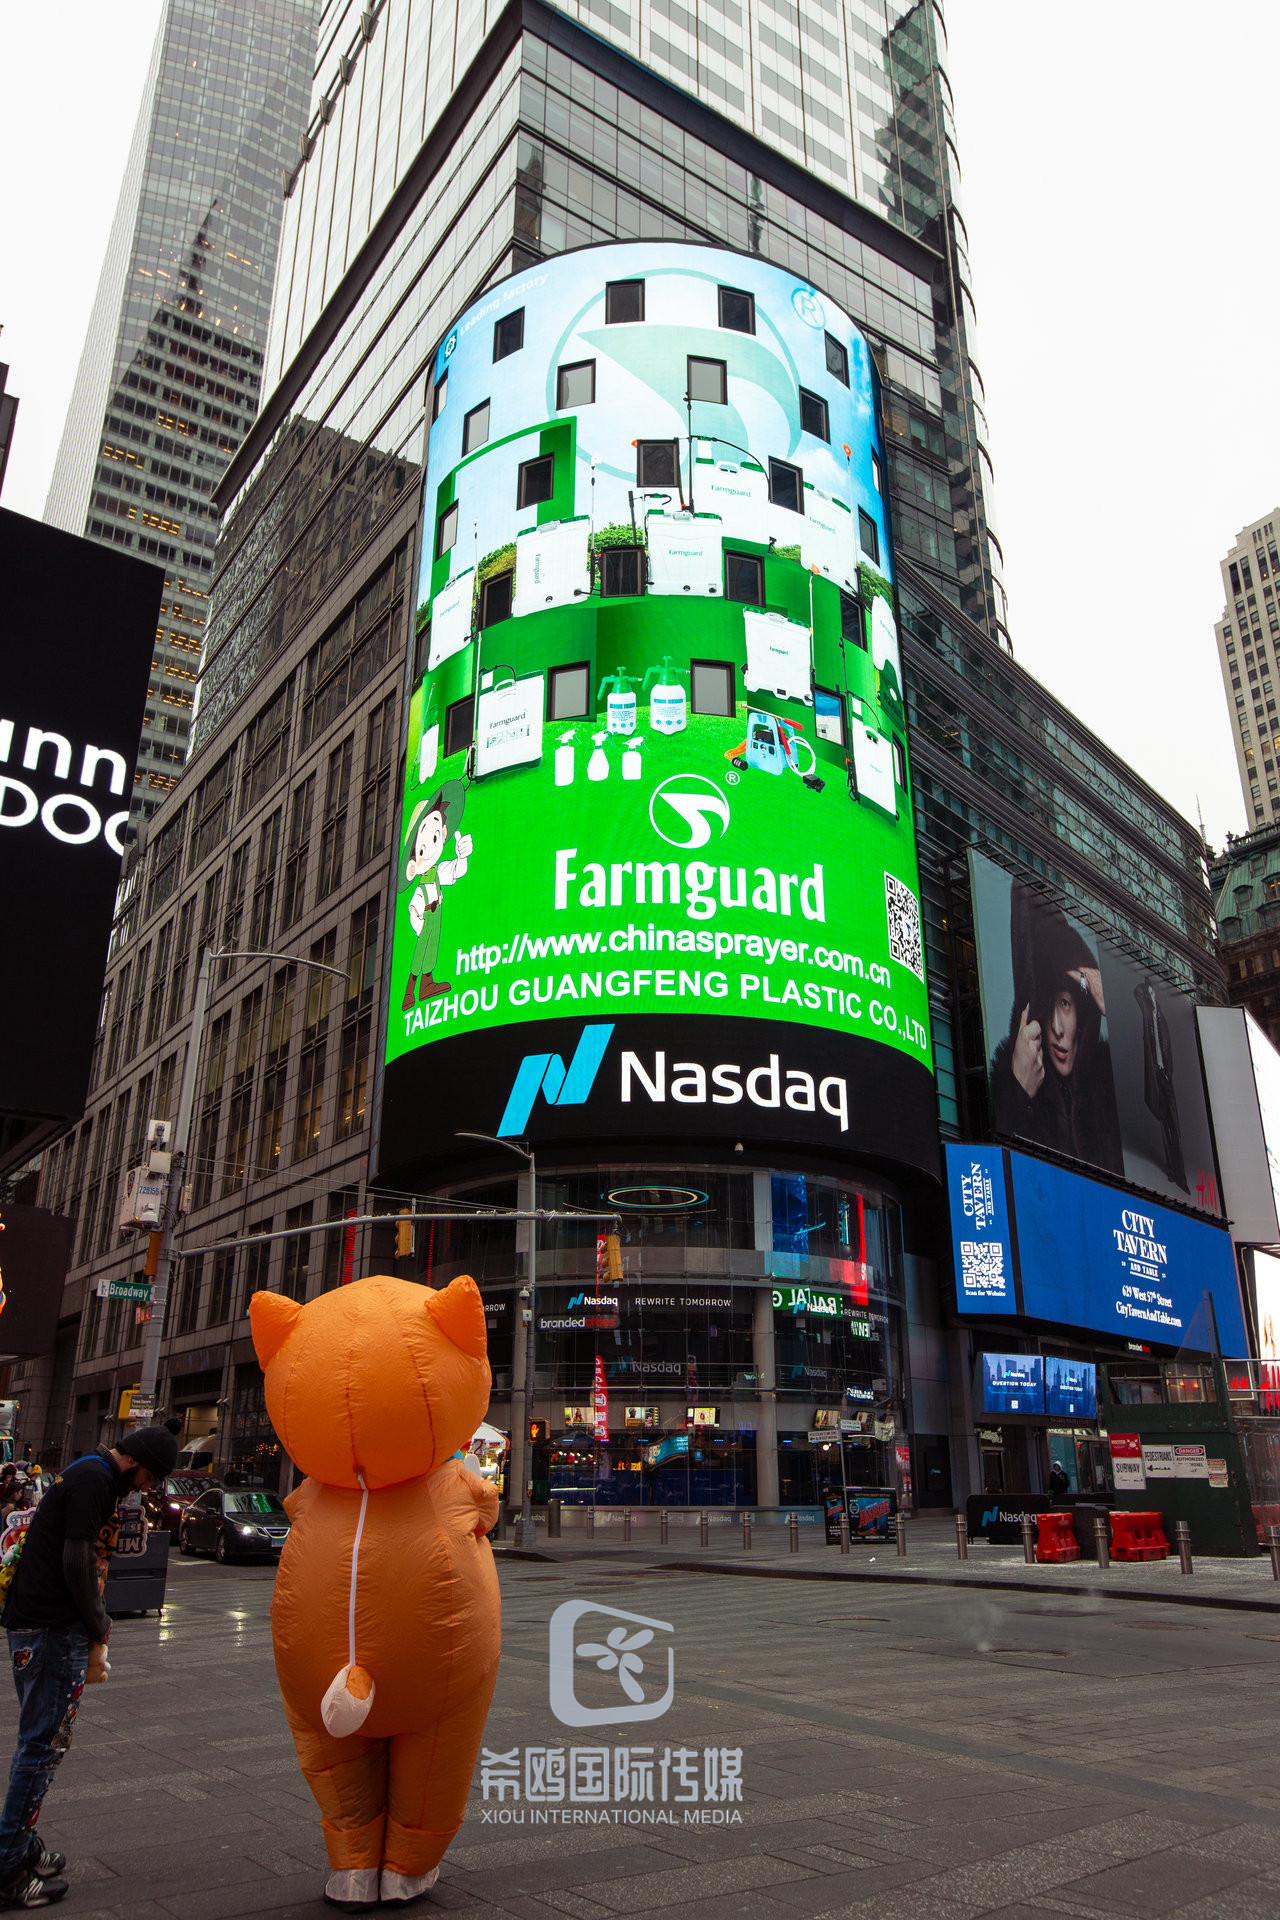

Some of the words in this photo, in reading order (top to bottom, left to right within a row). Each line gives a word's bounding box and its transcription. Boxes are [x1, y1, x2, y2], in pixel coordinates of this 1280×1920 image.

[460, 297, 501, 337] Leading
[503, 273, 549, 303] factory
[711, 484, 752, 498] Farmguard
[669, 549, 703, 557] Farmguard
[489, 711, 526, 730] Farmguard
[555, 848, 826, 923] Farmguard
[456, 923, 891, 989] http://www.chinasprayer.com.cn
[404, 984, 498, 1037] TAIZHOU
[508, 969, 728, 1006] GUANGFENG
[740, 973, 862, 1019] PLASTIC
[869, 1000, 927, 1050] CO.,LTD
[620, 1051, 849, 1133] Nasdaq
[961, 1174, 974, 1217] CITY
[970, 1162, 986, 1230] TAVERN
[1121, 1209, 1155, 1239] CITY
[1113, 1229, 1168, 1265] TAVERN
[1130, 1262, 1141, 1272] AND
[1142, 1266, 1159, 1277] TABLE
[109, 1283, 149, 1299] Broadway
[584, 1296, 618, 1306] Nasdaq
[635, 1297, 676, 1306] REWRITE
[680, 1297, 732, 1307] TOMORROW
[1122, 1284, 1132, 1297] 629
[1132, 1286, 1147, 1302] West
[1146, 1290, 1157, 1303] 57th
[1157, 1293, 1173, 1308] Street
[540, 1316, 616, 1329] brandedcities
[1116, 1301, 1182, 1328] CityTavernAndTable.com
[632, 1361, 681, 1375] Nasdaq
[1116, 1463, 1140, 1473] SUBWAY
[1144, 1451, 1172, 1461] PEDESTRIANS
[859, 1499, 891, 1529] AMAZE
